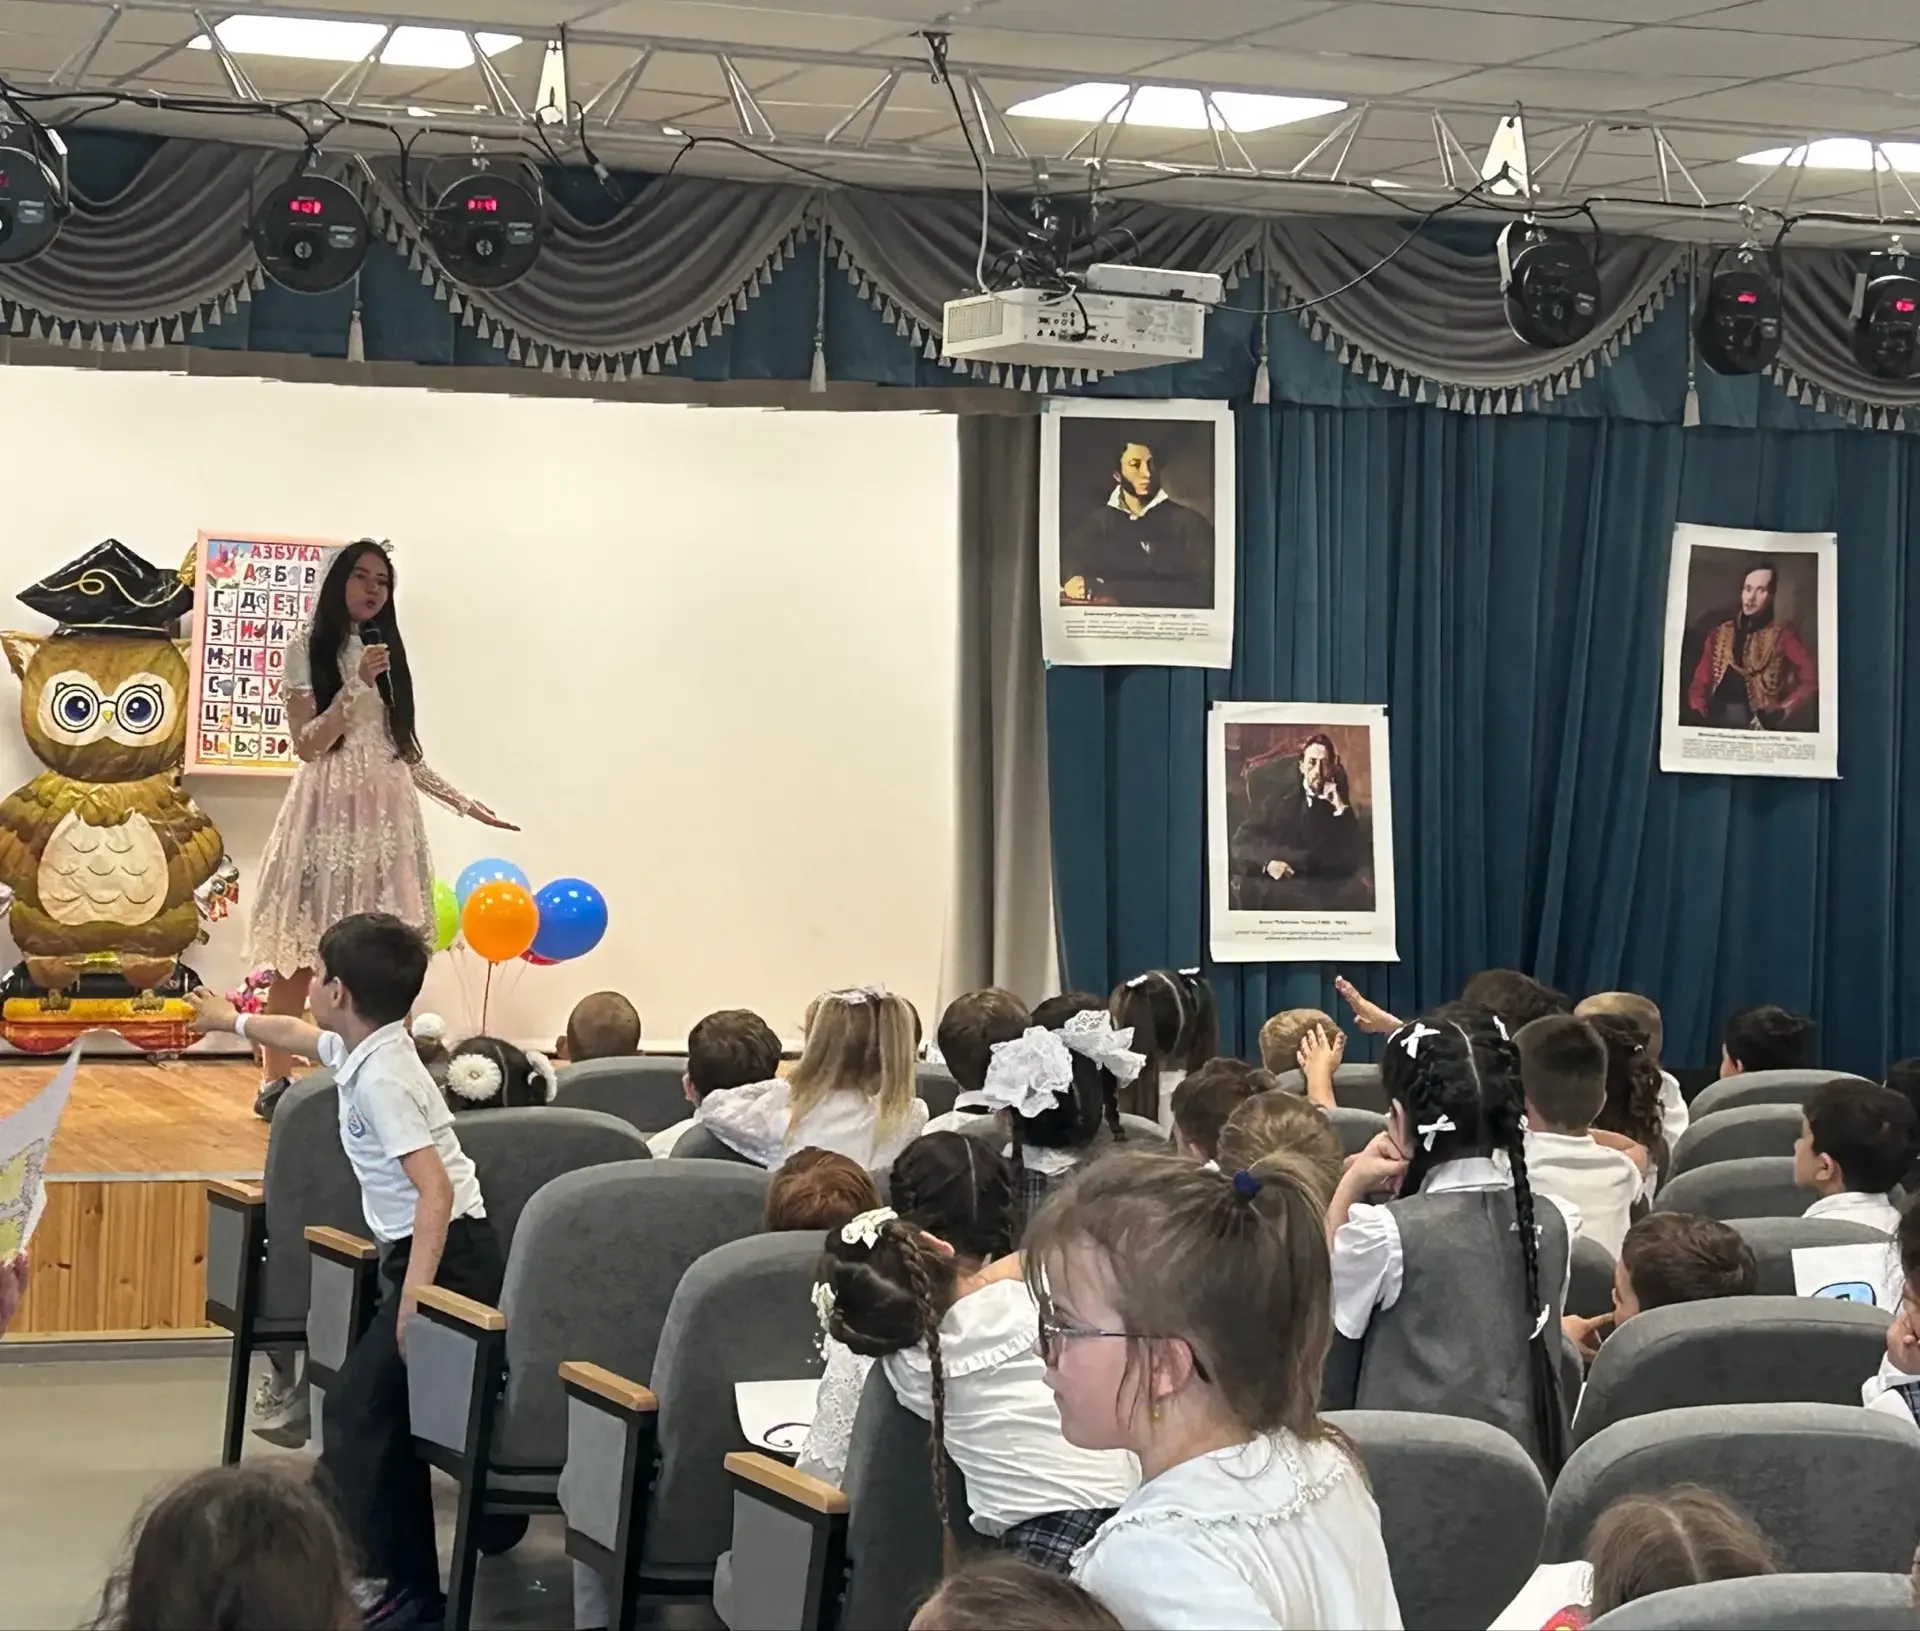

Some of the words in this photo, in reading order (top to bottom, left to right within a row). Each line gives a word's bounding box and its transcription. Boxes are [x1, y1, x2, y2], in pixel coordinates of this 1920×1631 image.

[250, 545, 321, 562] АЗБУКА
[243, 562, 257, 581] А
[274, 564, 287, 582] Б
[305, 567, 316, 584] В
[213, 590, 225, 607] Г
[240, 592, 256, 610] Д
[273, 593, 285, 611] Е
[211, 619, 222, 636] З
[240, 621, 254, 639] И
[207, 647, 223, 665] М
[240, 649, 252, 666] Н
[269, 650, 282, 668] О
[209, 676, 219, 693] С
[238, 677, 250, 695] Т
[268, 679, 281, 696] У
[205, 705, 219, 723] Ц
[236, 706, 249, 724] Ч
[264, 708, 281, 726] Ш
[202, 734, 219, 752] Ы
[234, 735, 248, 752] Ь
